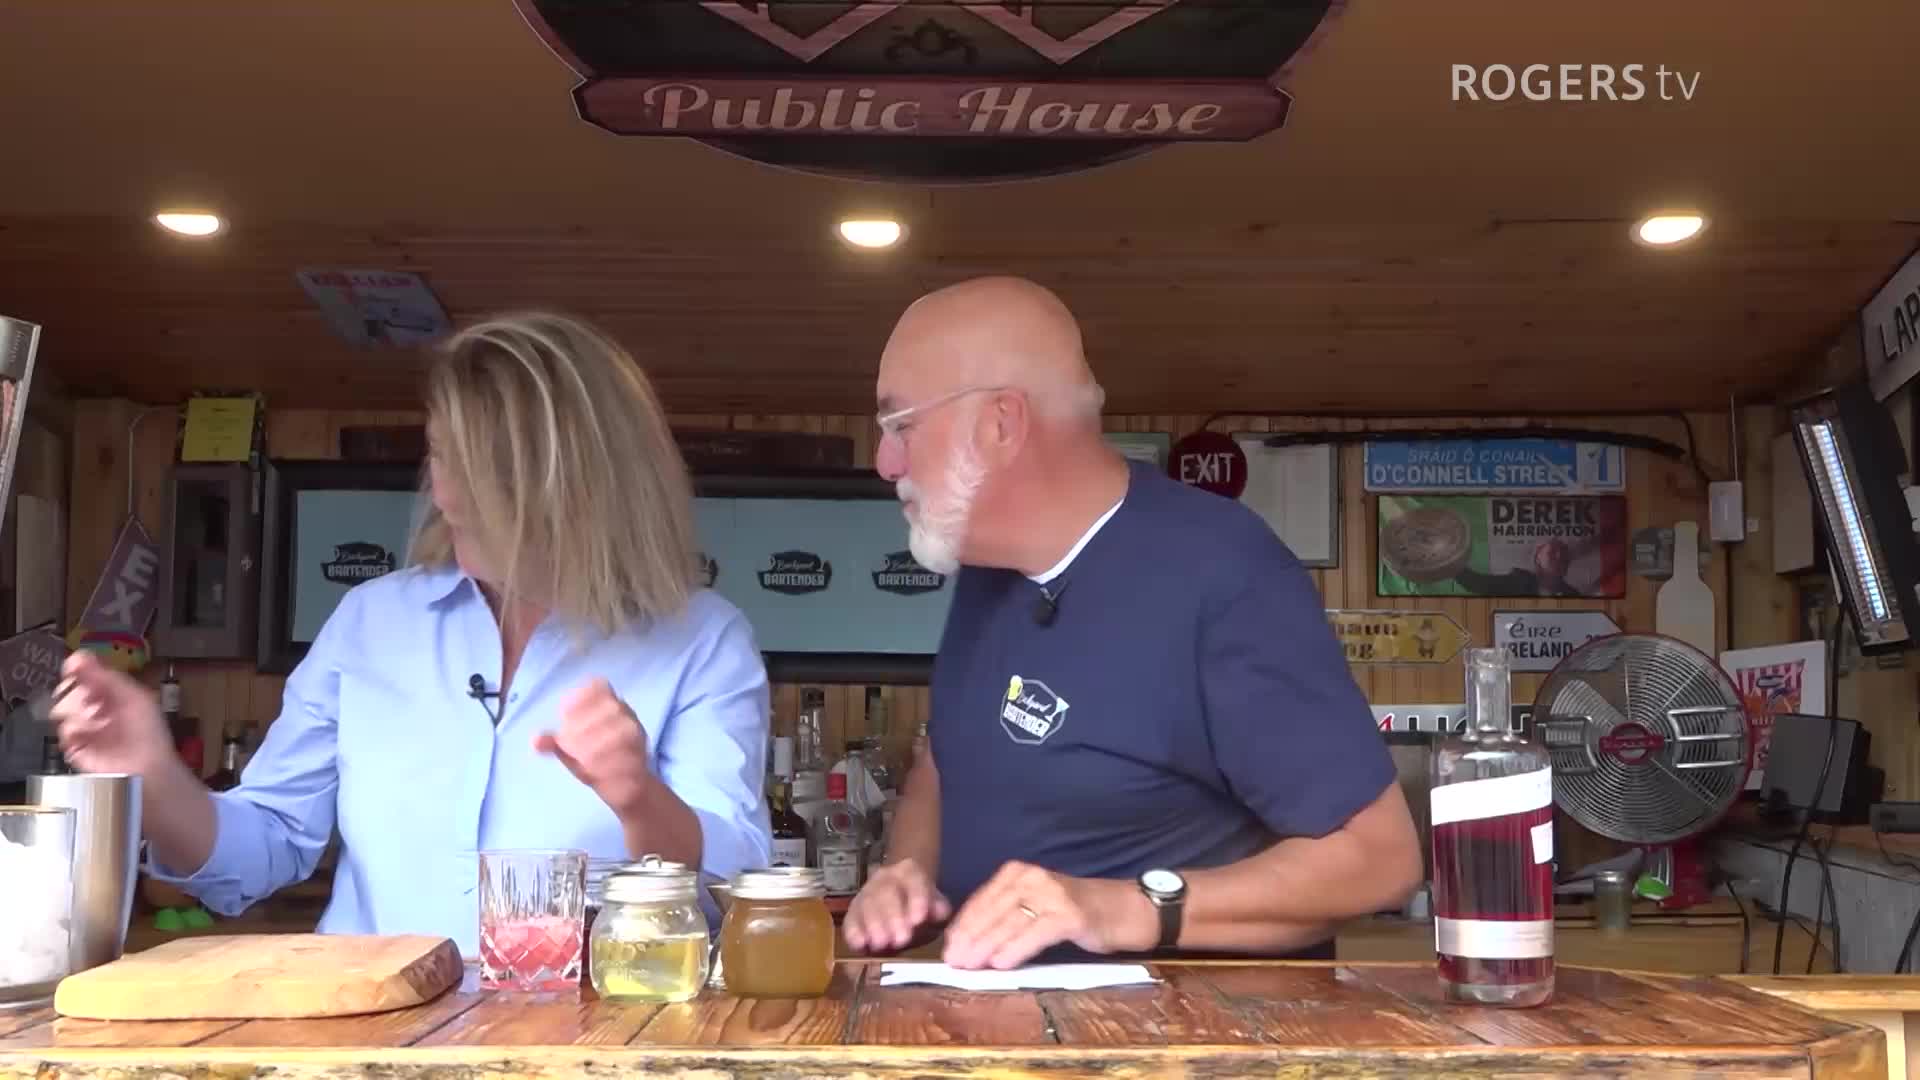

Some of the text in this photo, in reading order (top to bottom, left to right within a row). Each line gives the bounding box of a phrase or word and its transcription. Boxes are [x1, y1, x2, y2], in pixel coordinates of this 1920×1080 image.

[643, 83, 1222, 135] Public House
[1879, 284, 1920, 361] LAP
[1180, 452, 1236, 484] EXIT
[1493, 498, 1597, 524] DEREK
[1493, 525, 1596, 537] HARRINGTON
[763, 573, 825, 586] BARTENDER
[878, 573, 940, 586] BARTENDER
